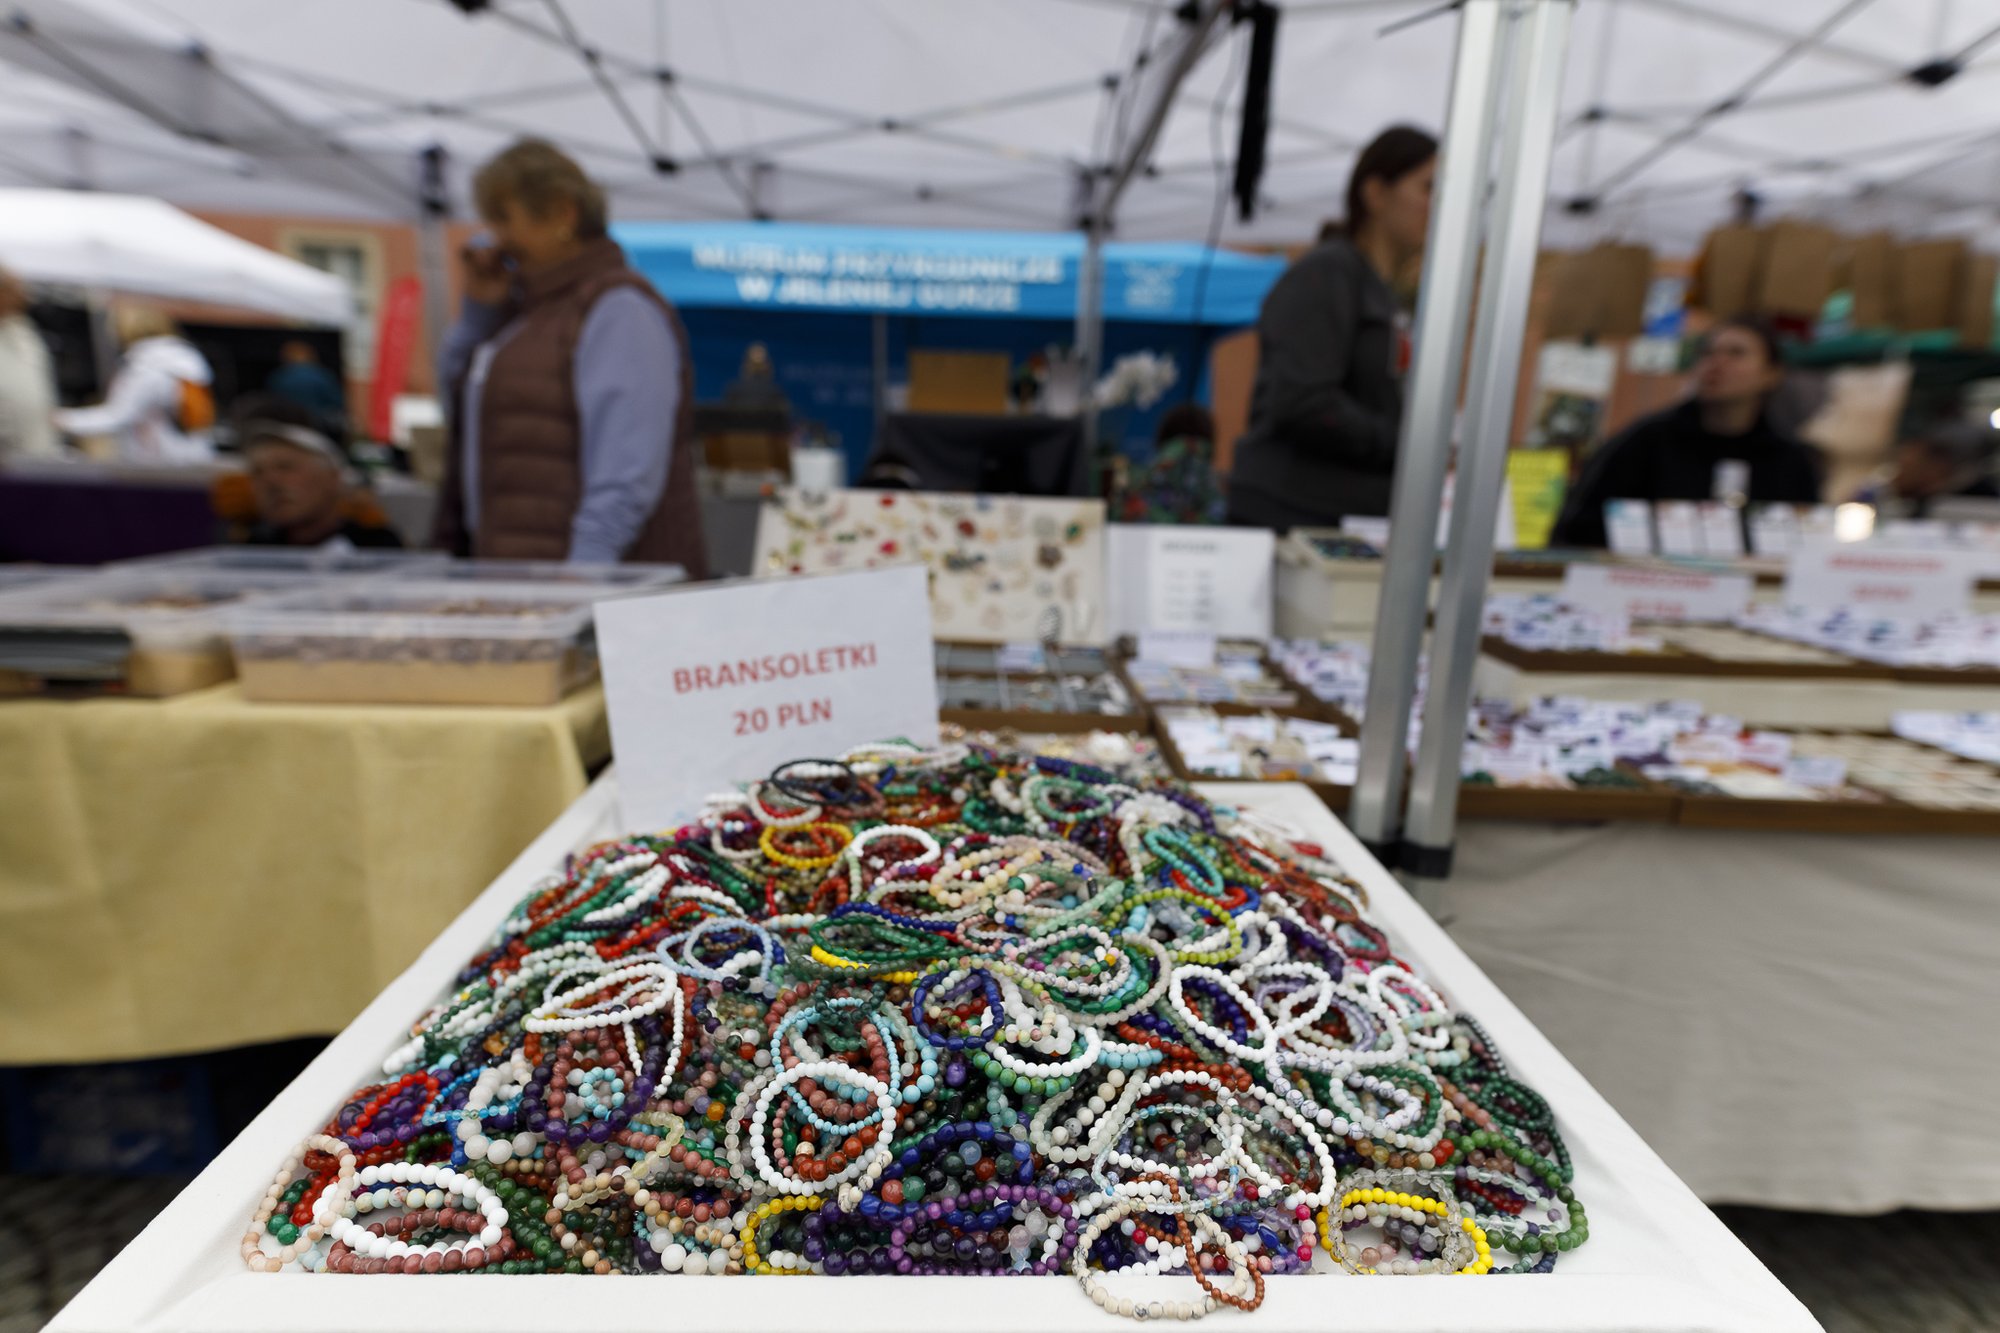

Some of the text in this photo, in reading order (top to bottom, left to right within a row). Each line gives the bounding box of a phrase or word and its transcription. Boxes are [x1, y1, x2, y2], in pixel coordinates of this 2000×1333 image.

[672, 643, 877, 695] BRANSOLETKI
[733, 699, 833, 737] 20 PLN
